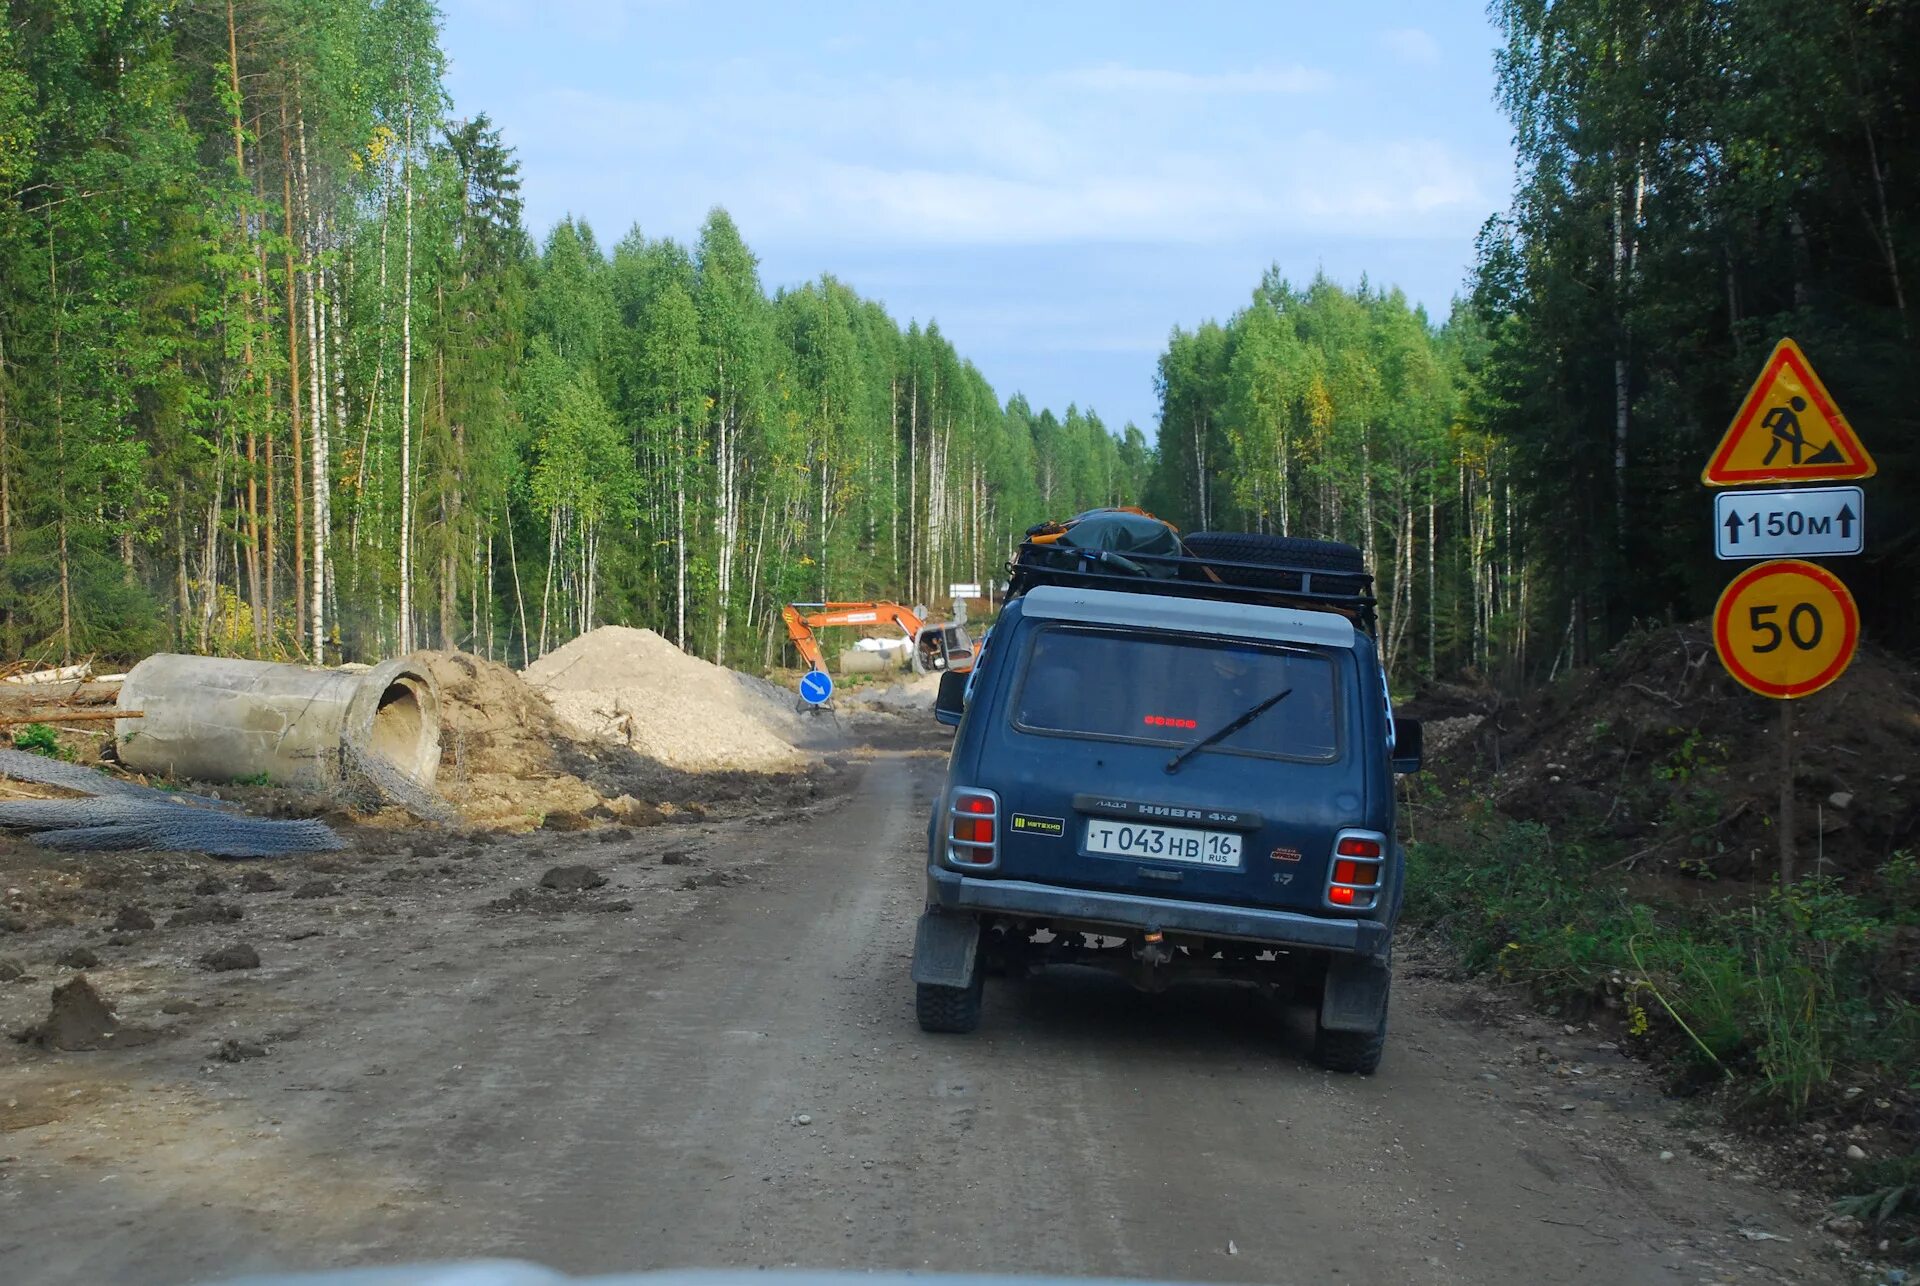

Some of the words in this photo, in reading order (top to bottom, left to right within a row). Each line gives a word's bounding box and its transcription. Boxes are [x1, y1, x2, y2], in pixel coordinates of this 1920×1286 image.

[1749, 602, 1823, 653] 50
[1095, 800, 1127, 809] ЛАДА
[1138, 805, 1202, 819] НИВА
[1208, 835, 1232, 855] 16
[1208, 854, 1228, 863] RUS
